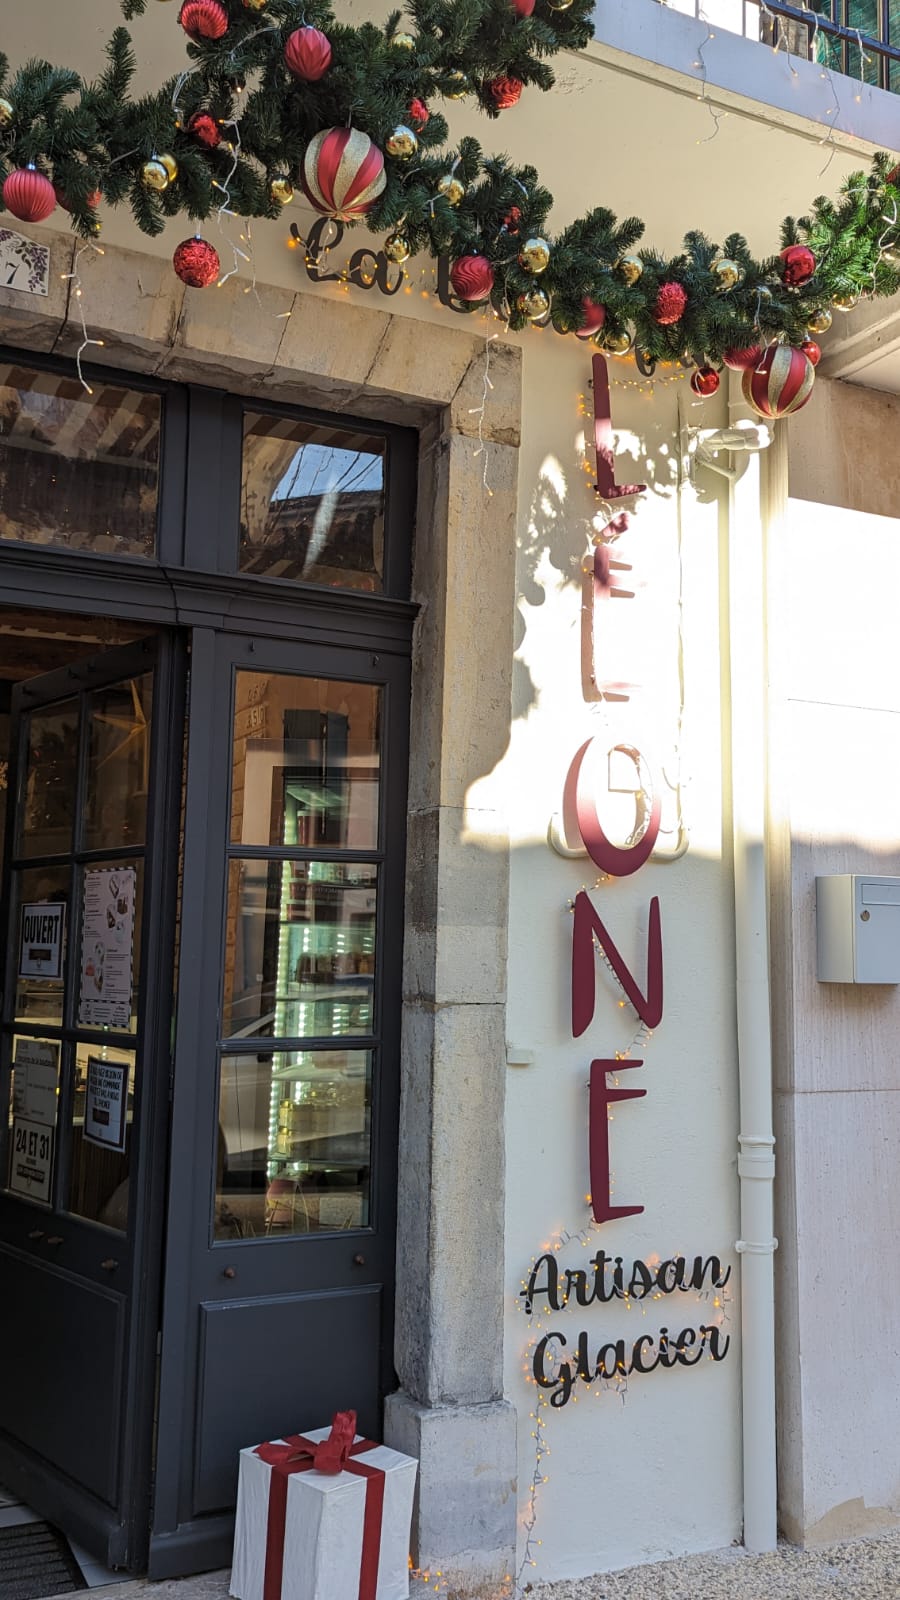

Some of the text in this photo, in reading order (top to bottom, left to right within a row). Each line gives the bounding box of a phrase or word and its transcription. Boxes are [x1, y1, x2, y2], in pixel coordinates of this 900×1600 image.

[290, 216, 404, 296] La
[24, 915, 59, 944] OUVERT
[16, 1128, 49, 1160] 24 ET 31
[520, 1250, 732, 1315] Artisan
[533, 1324, 730, 1408] Glacier
